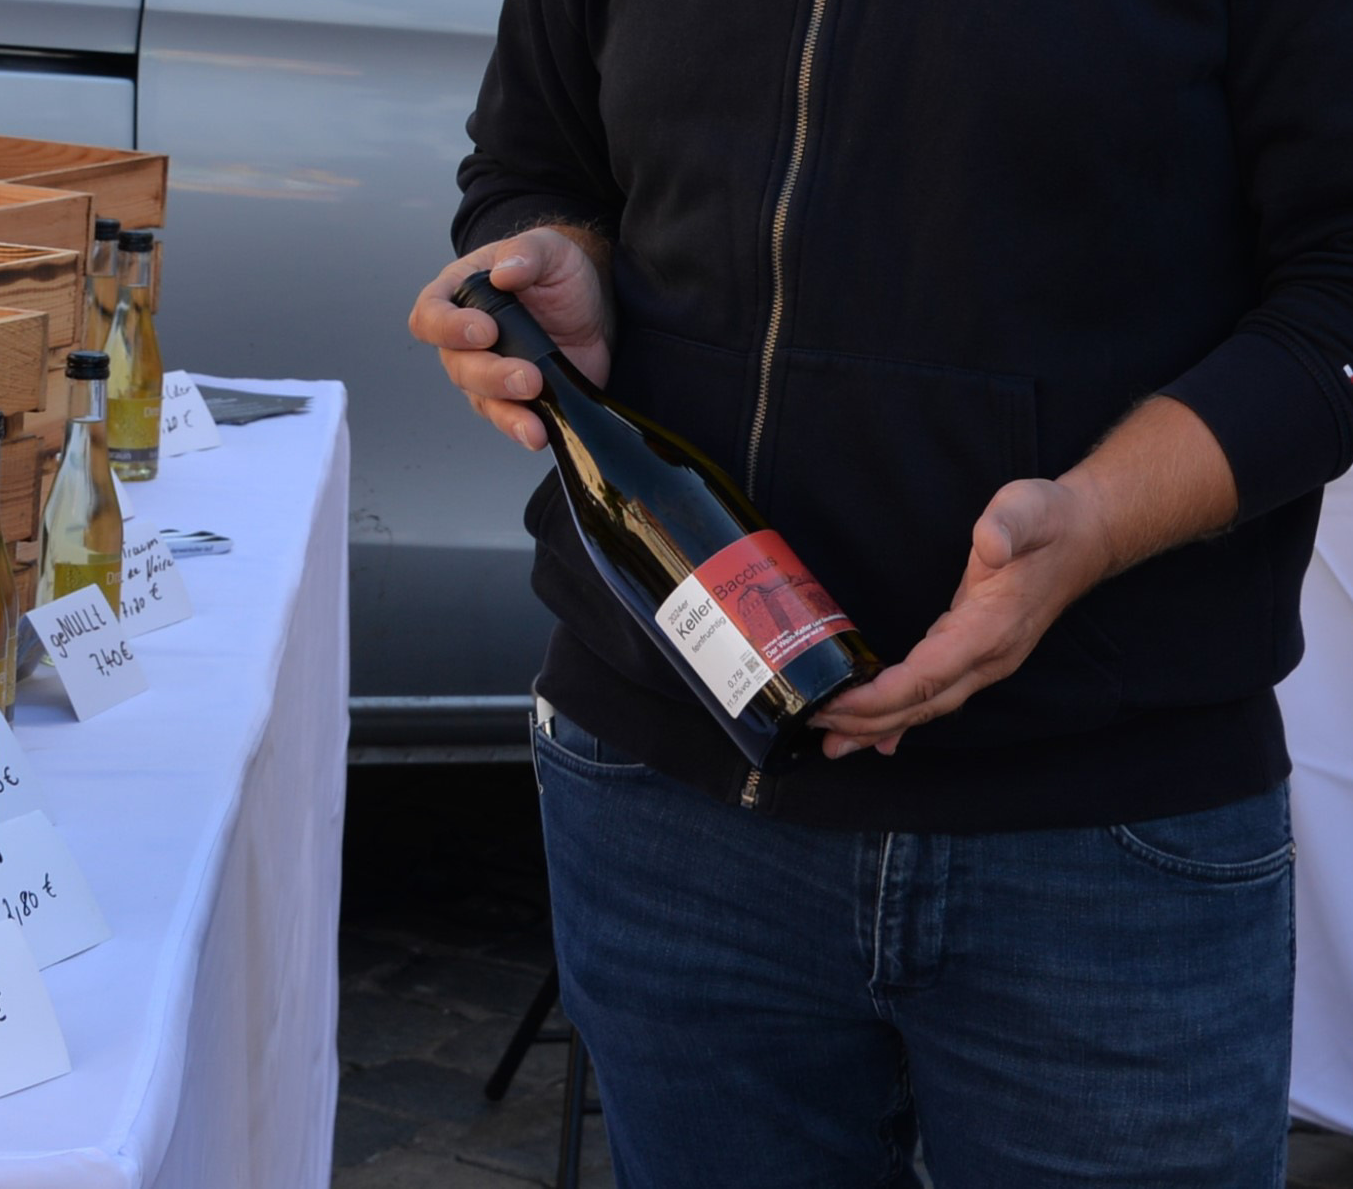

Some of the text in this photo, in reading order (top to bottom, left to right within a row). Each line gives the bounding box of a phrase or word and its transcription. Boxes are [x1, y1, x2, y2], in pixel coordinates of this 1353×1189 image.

[675, 554, 778, 641] Keller Bacchus
[691, 615, 727, 653] feinfruchtig
[42, 872, 57, 898] €
